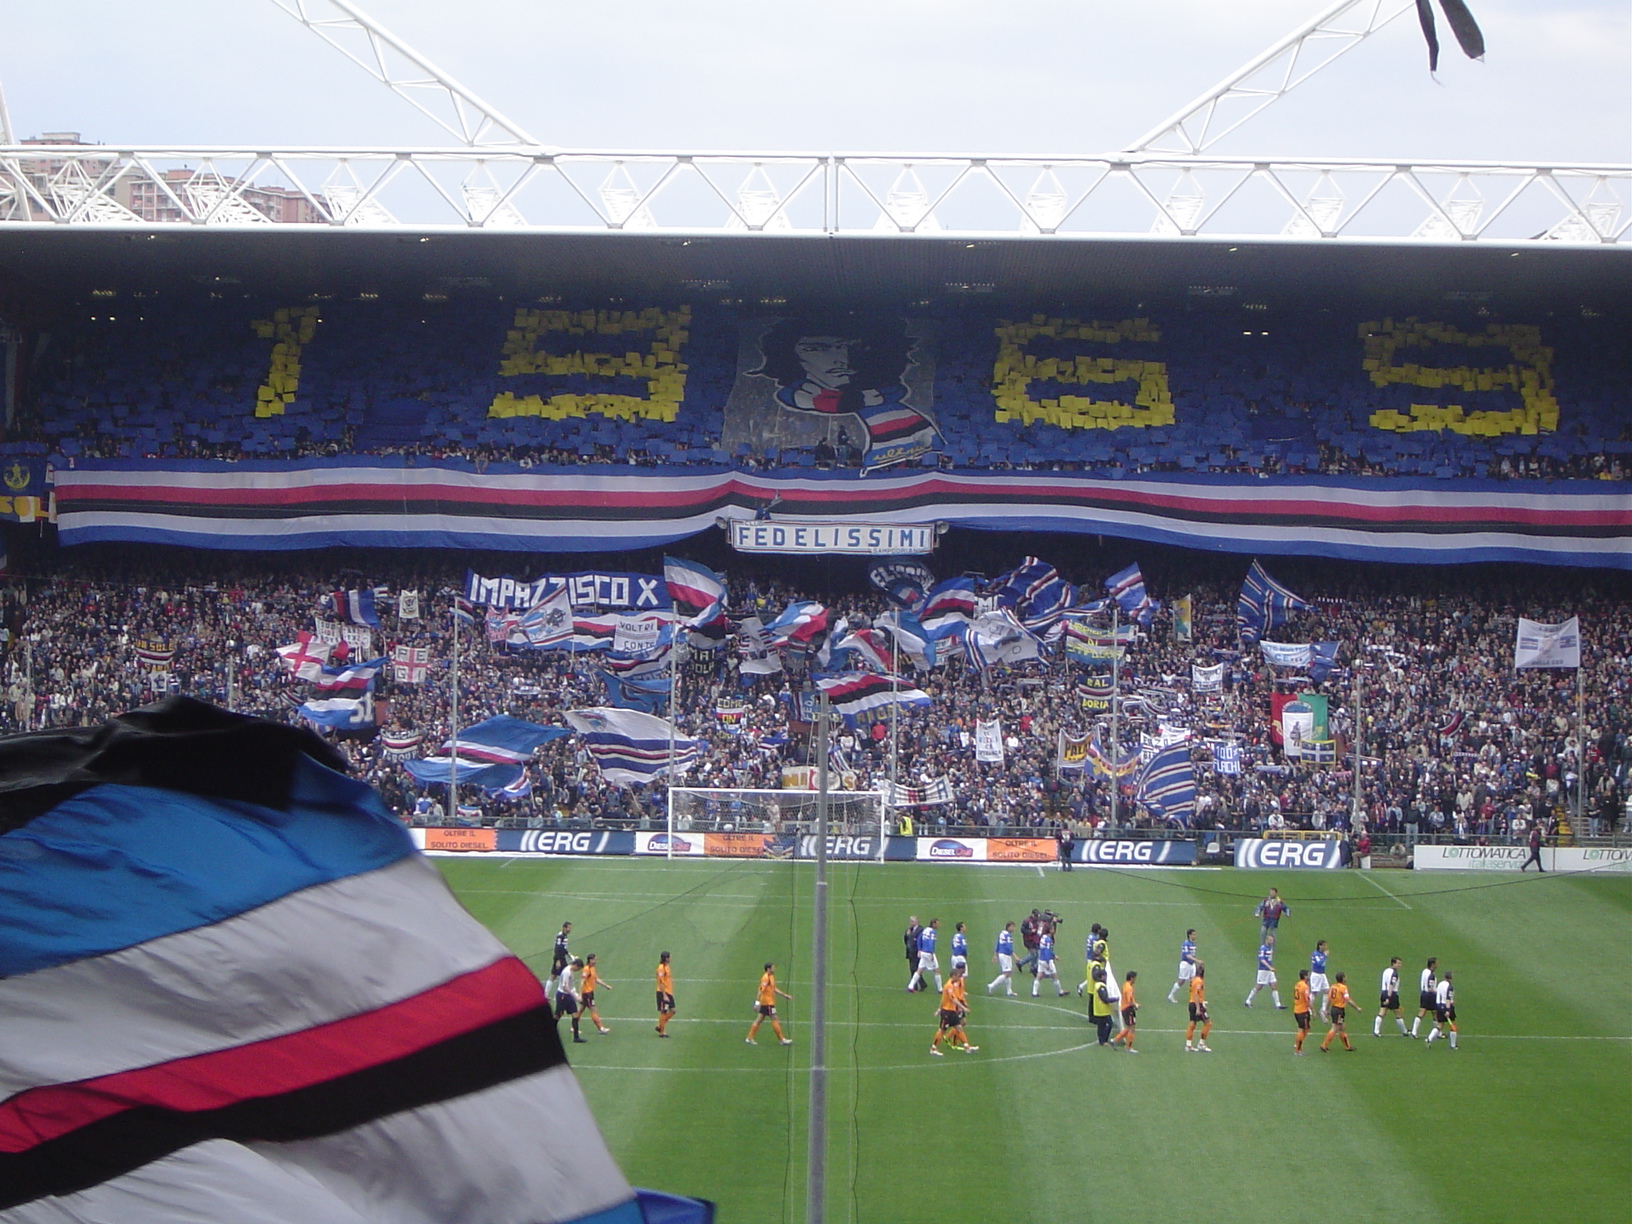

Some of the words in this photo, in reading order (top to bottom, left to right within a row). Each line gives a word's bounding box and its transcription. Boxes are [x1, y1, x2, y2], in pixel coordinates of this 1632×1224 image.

[487, 304, 691, 422] 9
[991, 314, 1175, 430] 6
[1357, 317, 1559, 436] 9
[739, 527, 925, 547] FEDELISSIMI
[636, 577, 658, 606] X
[620, 621, 653, 631] VOLTRI
[717, 698, 743, 708] COME
[722, 714, 736, 723] ON
[538, 832, 592, 851] ERG
[1099, 841, 1153, 861] ERG
[1260, 842, 1326, 866] ERG
[1442, 847, 1526, 859] LOTTOMATICA
